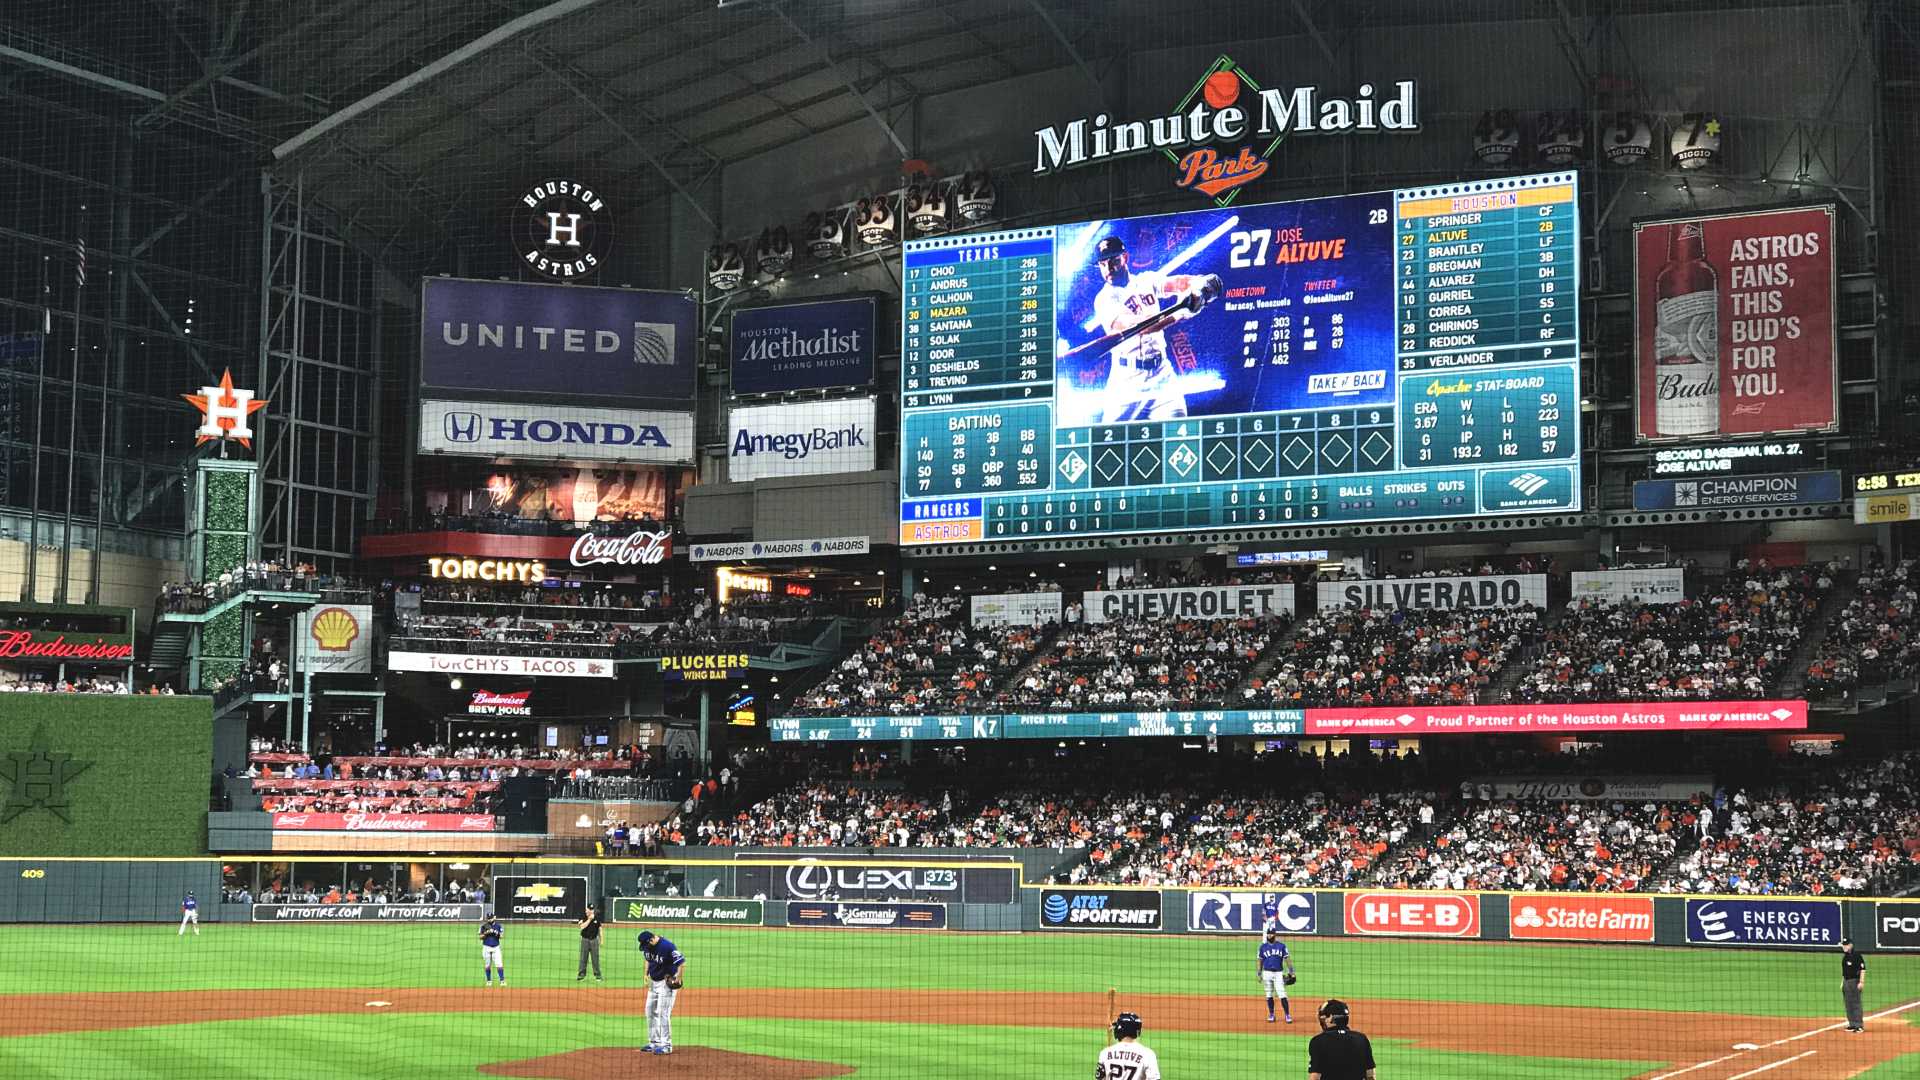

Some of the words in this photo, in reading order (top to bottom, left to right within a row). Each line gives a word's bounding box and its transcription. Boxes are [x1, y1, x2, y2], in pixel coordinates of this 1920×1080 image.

[1034, 104, 1246, 174] Minute
[1257, 81, 1418, 134] Maid
[1682, 113, 1704, 146] 7
[1678, 150, 1711, 160] BIGGIO
[1176, 145, 1267, 194] Park
[523, 181, 603, 212] HOUSTON
[1452, 193, 1517, 211] HOUSTON
[856, 196, 889, 226] 33
[1369, 208, 1388, 225] 2B
[1428, 213, 1482, 228] SPRINGER
[546, 212, 581, 246] H
[1275, 227, 1303, 244] JOSE
[1428, 229, 1468, 243] ALTUVE
[1230, 229, 1272, 269] 27
[1276, 239, 1346, 264] ALTUVE
[1428, 243, 1484, 258] BRANTLEY
[1730, 232, 1819, 261] ASTROS
[958, 247, 999, 263] TEXAS
[525, 250, 597, 276] ASTROS
[1428, 259, 1482, 273] BREGMAN
[930, 266, 954, 277] CHOO
[1731, 262, 1795, 289] FANS,
[930, 278, 968, 291] ANDRUS
[1304, 279, 1336, 292] TWITTER
[1428, 274, 1475, 288] ALVAREZ
[930, 292, 973, 304] CALHOUN
[1225, 286, 1266, 298] HOMETOWN
[1428, 289, 1474, 303] GURRIEL
[1731, 290, 1783, 316] THIS
[930, 306, 967, 318] MAZARA
[1429, 305, 1472, 318] CORREA
[740, 328, 788, 338] HOUSTON
[930, 319, 972, 332] SANTANA
[1429, 319, 1479, 333] CHIRINOS
[1732, 316, 1801, 344] BUD'S
[443, 322, 620, 353] UNITED
[740, 327, 861, 361] Methodist
[929, 334, 960, 346] SOLAK
[1429, 334, 1475, 348] REDDICK
[929, 349, 954, 360] ODOR
[1429, 352, 1494, 367] VERLANDER
[1732, 346, 1776, 370] FOR
[773, 362, 812, 371] LEADING
[929, 360, 980, 373] DESHIELDS
[929, 375, 968, 387] TREVINO
[1313, 376, 1337, 390] TAKE
[1353, 374, 1381, 387] BACK
[1475, 377, 1544, 392] STAT-BOARD
[1732, 372, 1785, 397] YOU.
[929, 394, 953, 405] LYNN
[195, 386, 254, 438] H
[1414, 402, 1438, 414] ERA
[949, 414, 1001, 431] BATTING
[1414, 416, 1438, 429] 3.67
[1538, 408, 1559, 421] 223
[489, 418, 672, 448] HONDA
[1453, 445, 1482, 459] 193.2
[1498, 443, 1518, 456] 182
[1655, 450, 1702, 461] SECOND
[1764, 446, 1784, 456] NO.
[1655, 462, 1684, 473] JOSE
[1339, 485, 1373, 497] BALLS
[1384, 481, 1427, 494] STRIKES
[1437, 480, 1465, 491] OUTS
[1700, 478, 1797, 495] CHAMPION
[1857, 475, 1888, 491] 8:58
[1702, 495, 1744, 505] ENERGY
[1745, 492, 1797, 502] SERVICES
[914, 502, 970, 518] RANGERS
[1870, 501, 1907, 515] smile
[915, 524, 970, 539] ASTROS
[706, 547, 745, 557] NABORS
[764, 544, 804, 554] NABORS
[824, 541, 864, 551] NABORS
[1344, 579, 1521, 610] SILVERADO
[1102, 589, 1274, 620] CHEVROLET
[0, 629, 133, 658] Budweiser
[522, 660, 576, 674] TACOS
[661, 654, 749, 670] PLUCKERS
[684, 671, 708, 680] WING
[710, 671, 727, 680] BAR
[472, 691, 526, 705] Budweiser
[468, 705, 496, 714] BREW
[498, 705, 531, 715] HOUSE
[1680, 714, 1707, 722] BANK
[1709, 713, 1723, 721] OF
[1724, 713, 1769, 721] AMERICA
[773, 719, 800, 730] LYNN
[851, 718, 876, 727] BALLS
[890, 717, 922, 727] STRIKES
[938, 717, 962, 726] TOTAL
[973, 716, 986, 738] K
[1020, 715, 1045, 725] PITCH
[1048, 714, 1068, 724] TYPE
[1178, 712, 1196, 721] TEX
[1203, 712, 1223, 721] HOU
[1355, 718, 1395, 727] AMERICA
[1427, 715, 1462, 727] Proud
[1468, 714, 1514, 727] Partner
[1519, 714, 1532, 725] of
[1537, 714, 1558, 725] the
[1563, 713, 1617, 725] Houston
[1622, 712, 1665, 724] Astros
[782, 730, 800, 740] ERA
[857, 728, 871, 739] 24
[900, 727, 913, 738] 51
[943, 727, 957, 738] 75
[343, 813, 428, 830] Budweiser
[21, 869, 45, 879] 409
[926, 870, 953, 882] 373
[513, 904, 567, 914] CHEVROLET
[1070, 895, 1108, 909] AT&T
[276, 906, 363, 919] NITTOTIRE.COM
[377, 906, 461, 919] NITTOTIRE.COM
[694, 908, 712, 919] Car
[712, 908, 748, 920] Rental
[853, 908, 897, 920] Germania
[1070, 909, 1157, 924] SPORTSNET
[1743, 911, 1811, 925] ENERGY
[1744, 926, 1830, 942] TRANSFER
[1107, 1050, 1143, 1064] ALTUVE
[1109, 1063, 1138, 1080] 27
